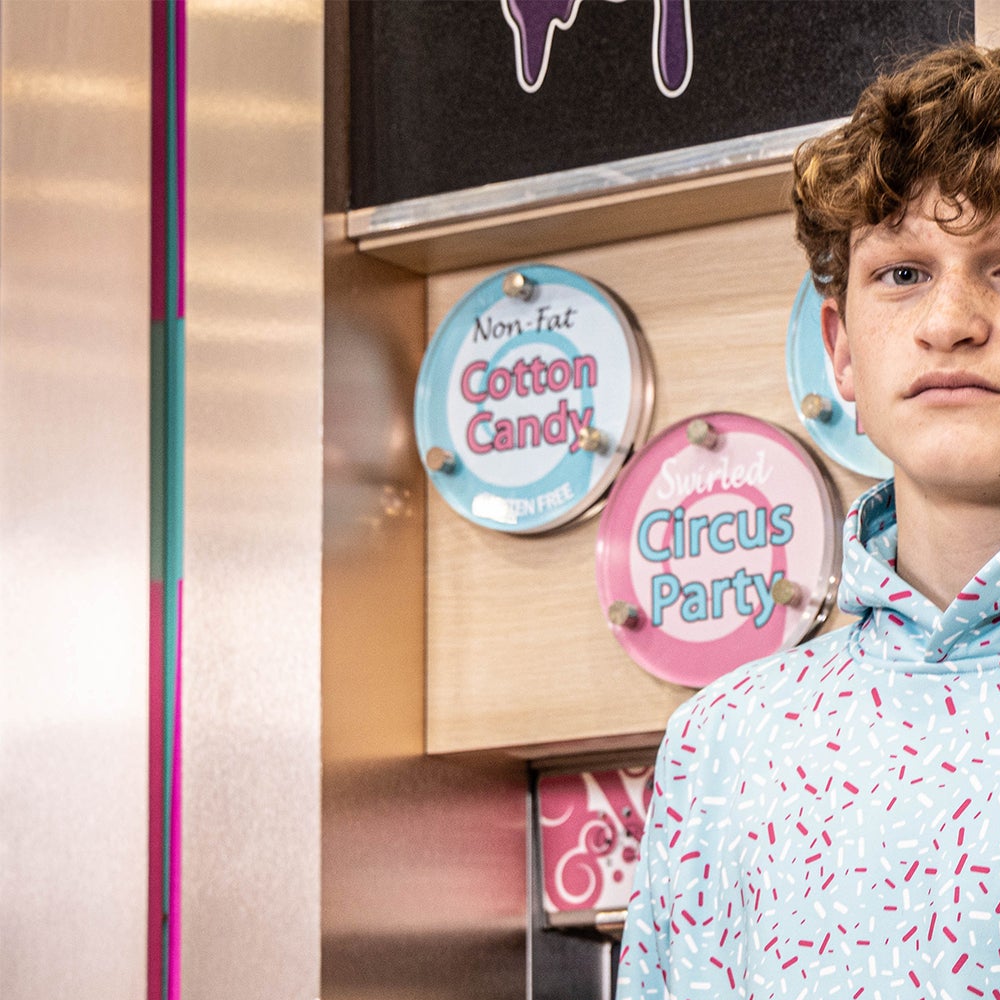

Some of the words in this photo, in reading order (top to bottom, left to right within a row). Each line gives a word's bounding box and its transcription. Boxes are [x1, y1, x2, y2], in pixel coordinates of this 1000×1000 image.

[472, 305, 578, 343] Non-Fat
[460, 354, 598, 404] Cotton
[466, 399, 594, 455] Candy
[536, 481, 575, 513] FREE
[656, 450, 774, 499] Swirled
[637, 503, 794, 562] Circus
[650, 567, 786, 628] Party
